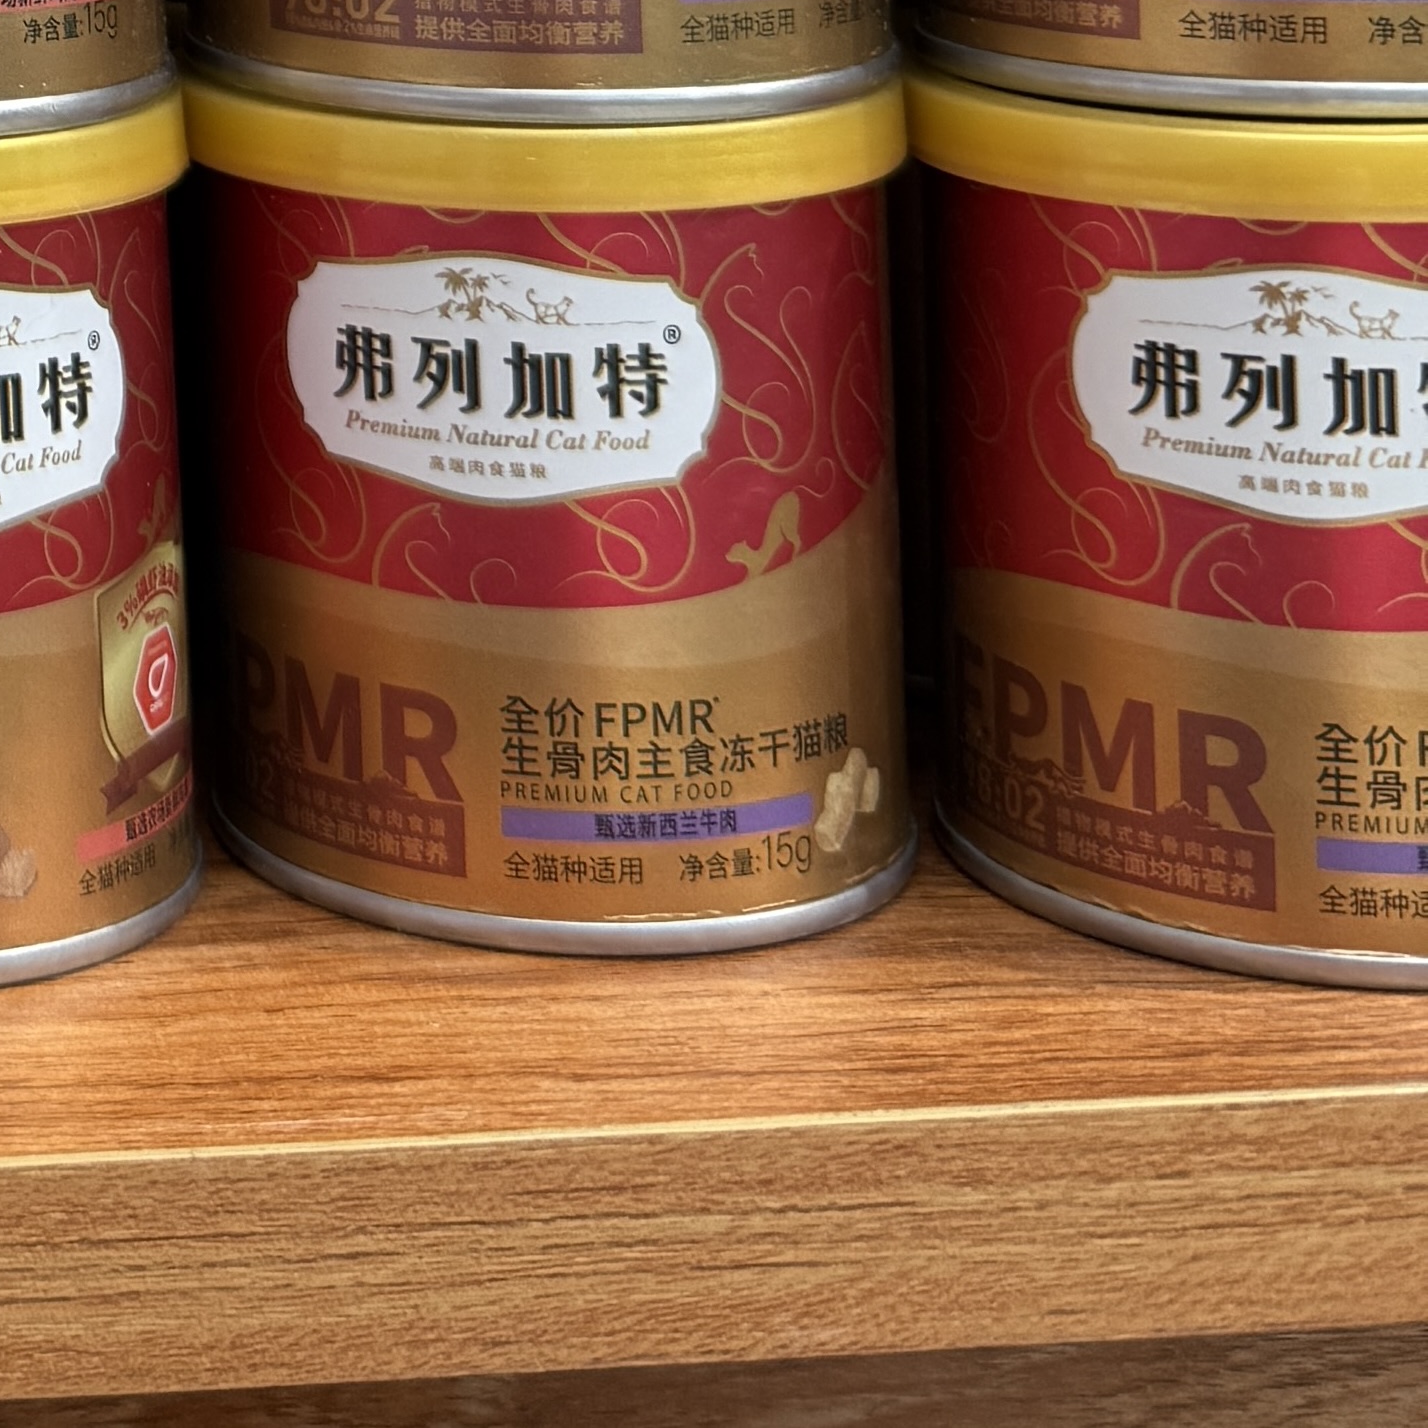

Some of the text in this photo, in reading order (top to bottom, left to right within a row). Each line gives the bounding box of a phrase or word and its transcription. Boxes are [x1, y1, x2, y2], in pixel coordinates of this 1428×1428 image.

[414, 16, 625, 46] 提供全面均衡营养
[333, 324, 670, 419] 弗列加特
[345, 409, 650, 451] Premium Natural Cat Food
[500, 695, 715, 738] 全价FPMR
[500, 712, 849, 781] 生骨肉主食冻干猫粮
[594, 808, 737, 841] 甄选新西兰牛肉
[503, 832, 814, 886] 全猫种适用 净含量:15g
